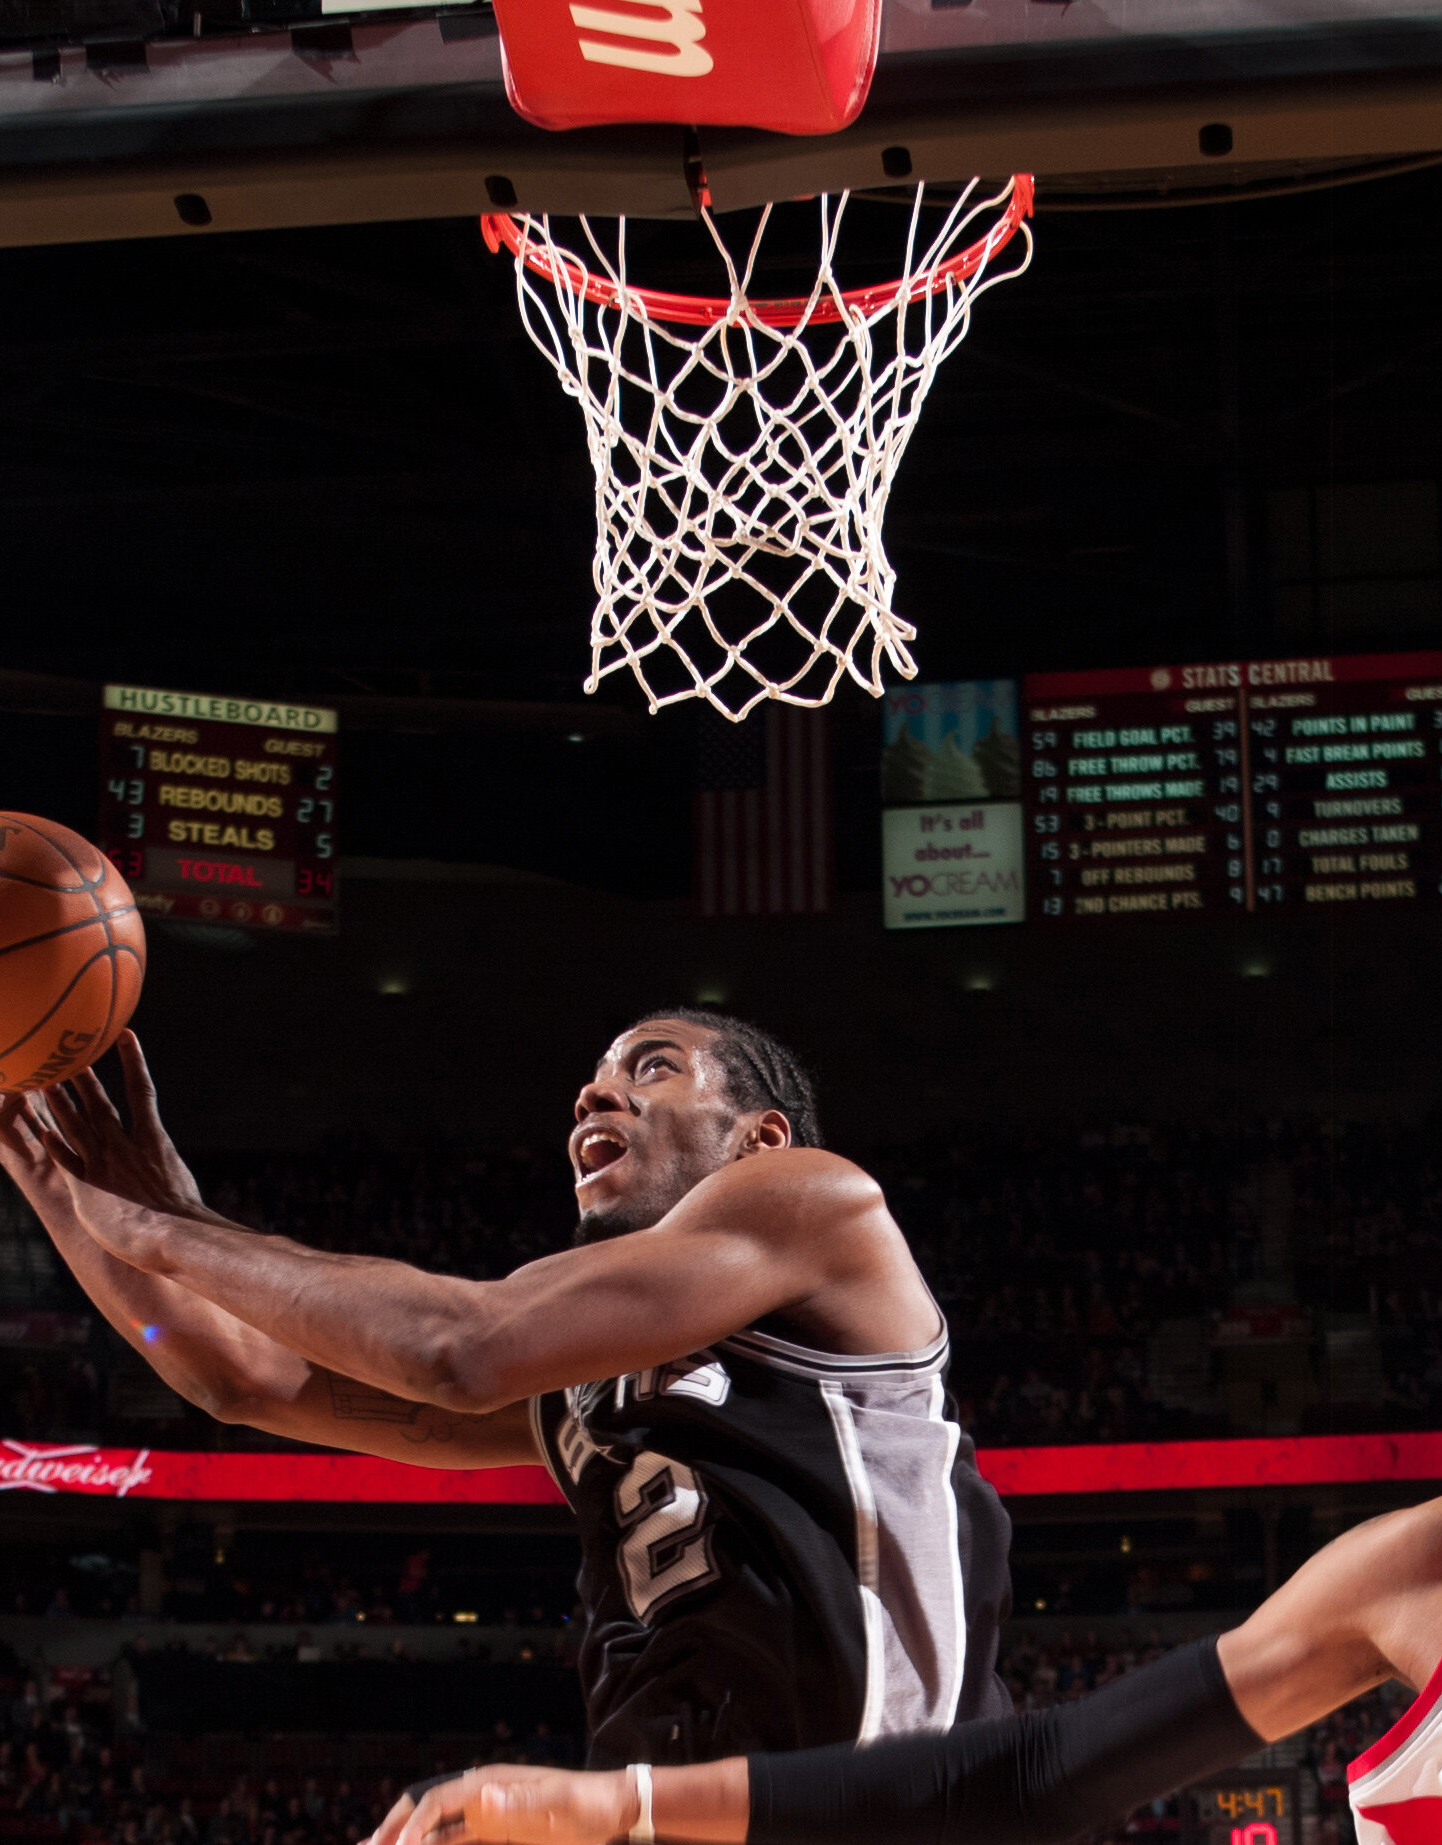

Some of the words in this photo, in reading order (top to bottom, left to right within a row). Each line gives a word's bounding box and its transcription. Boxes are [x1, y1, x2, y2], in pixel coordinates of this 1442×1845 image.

[1181, 663, 1242, 690] STATS
[1247, 660, 1337, 686] CENTRAL
[119, 690, 321, 729] HUSTLEBOARD
[1290, 715, 1348, 737] POINTS
[1349, 713, 1368, 735] IN
[1370, 711, 1417, 733] PAINT
[113, 720, 200, 745] BLAZERS
[264, 737, 327, 758] GUEST
[1071, 728, 1118, 750] FIELD
[1118, 726, 1159, 747] GOAL
[1285, 744, 1321, 765] FAST
[1322, 741, 1370, 763] BREAK
[1371, 738, 1426, 760] POINTS
[130, 745, 146, 769] 7
[149, 748, 231, 779] BLOCKED
[233, 758, 292, 786] SHOTS
[315, 766, 334, 791] 2
[1067, 755, 1109, 777] FREE
[1109, 753, 1164, 775] THROW
[1065, 782, 1105, 804] FREE
[1105, 780, 1163, 803] THROWS
[1324, 767, 1389, 791] ASSISTS
[108, 779, 145, 805] 43
[158, 783, 285, 819] REBOUNDS
[295, 798, 334, 824] 27
[1313, 796, 1404, 819] TURNOVERS
[920, 814, 953, 832] It's
[960, 810, 983, 831] all
[128, 813, 145, 839] 3
[167, 818, 276, 851] STEALS
[315, 832, 334, 858] 5
[1297, 825, 1370, 848] CHARGES
[1371, 822, 1421, 844] TAKEN
[1081, 866, 1110, 887] OFF
[1112, 862, 1196, 885] REBOUNDS
[1312, 854, 1356, 874] TOTAL
[1358, 852, 1409, 873] FOULS
[177, 858, 264, 888] TOTAL
[297, 867, 334, 895] 34
[1108, 892, 1169, 914] CHANCE
[1305, 882, 1358, 903] BENCH
[1360, 879, 1417, 900] POINTS
[614, 1445, 722, 1628] 2
[1217, 1786, 1285, 1819] 4:47
